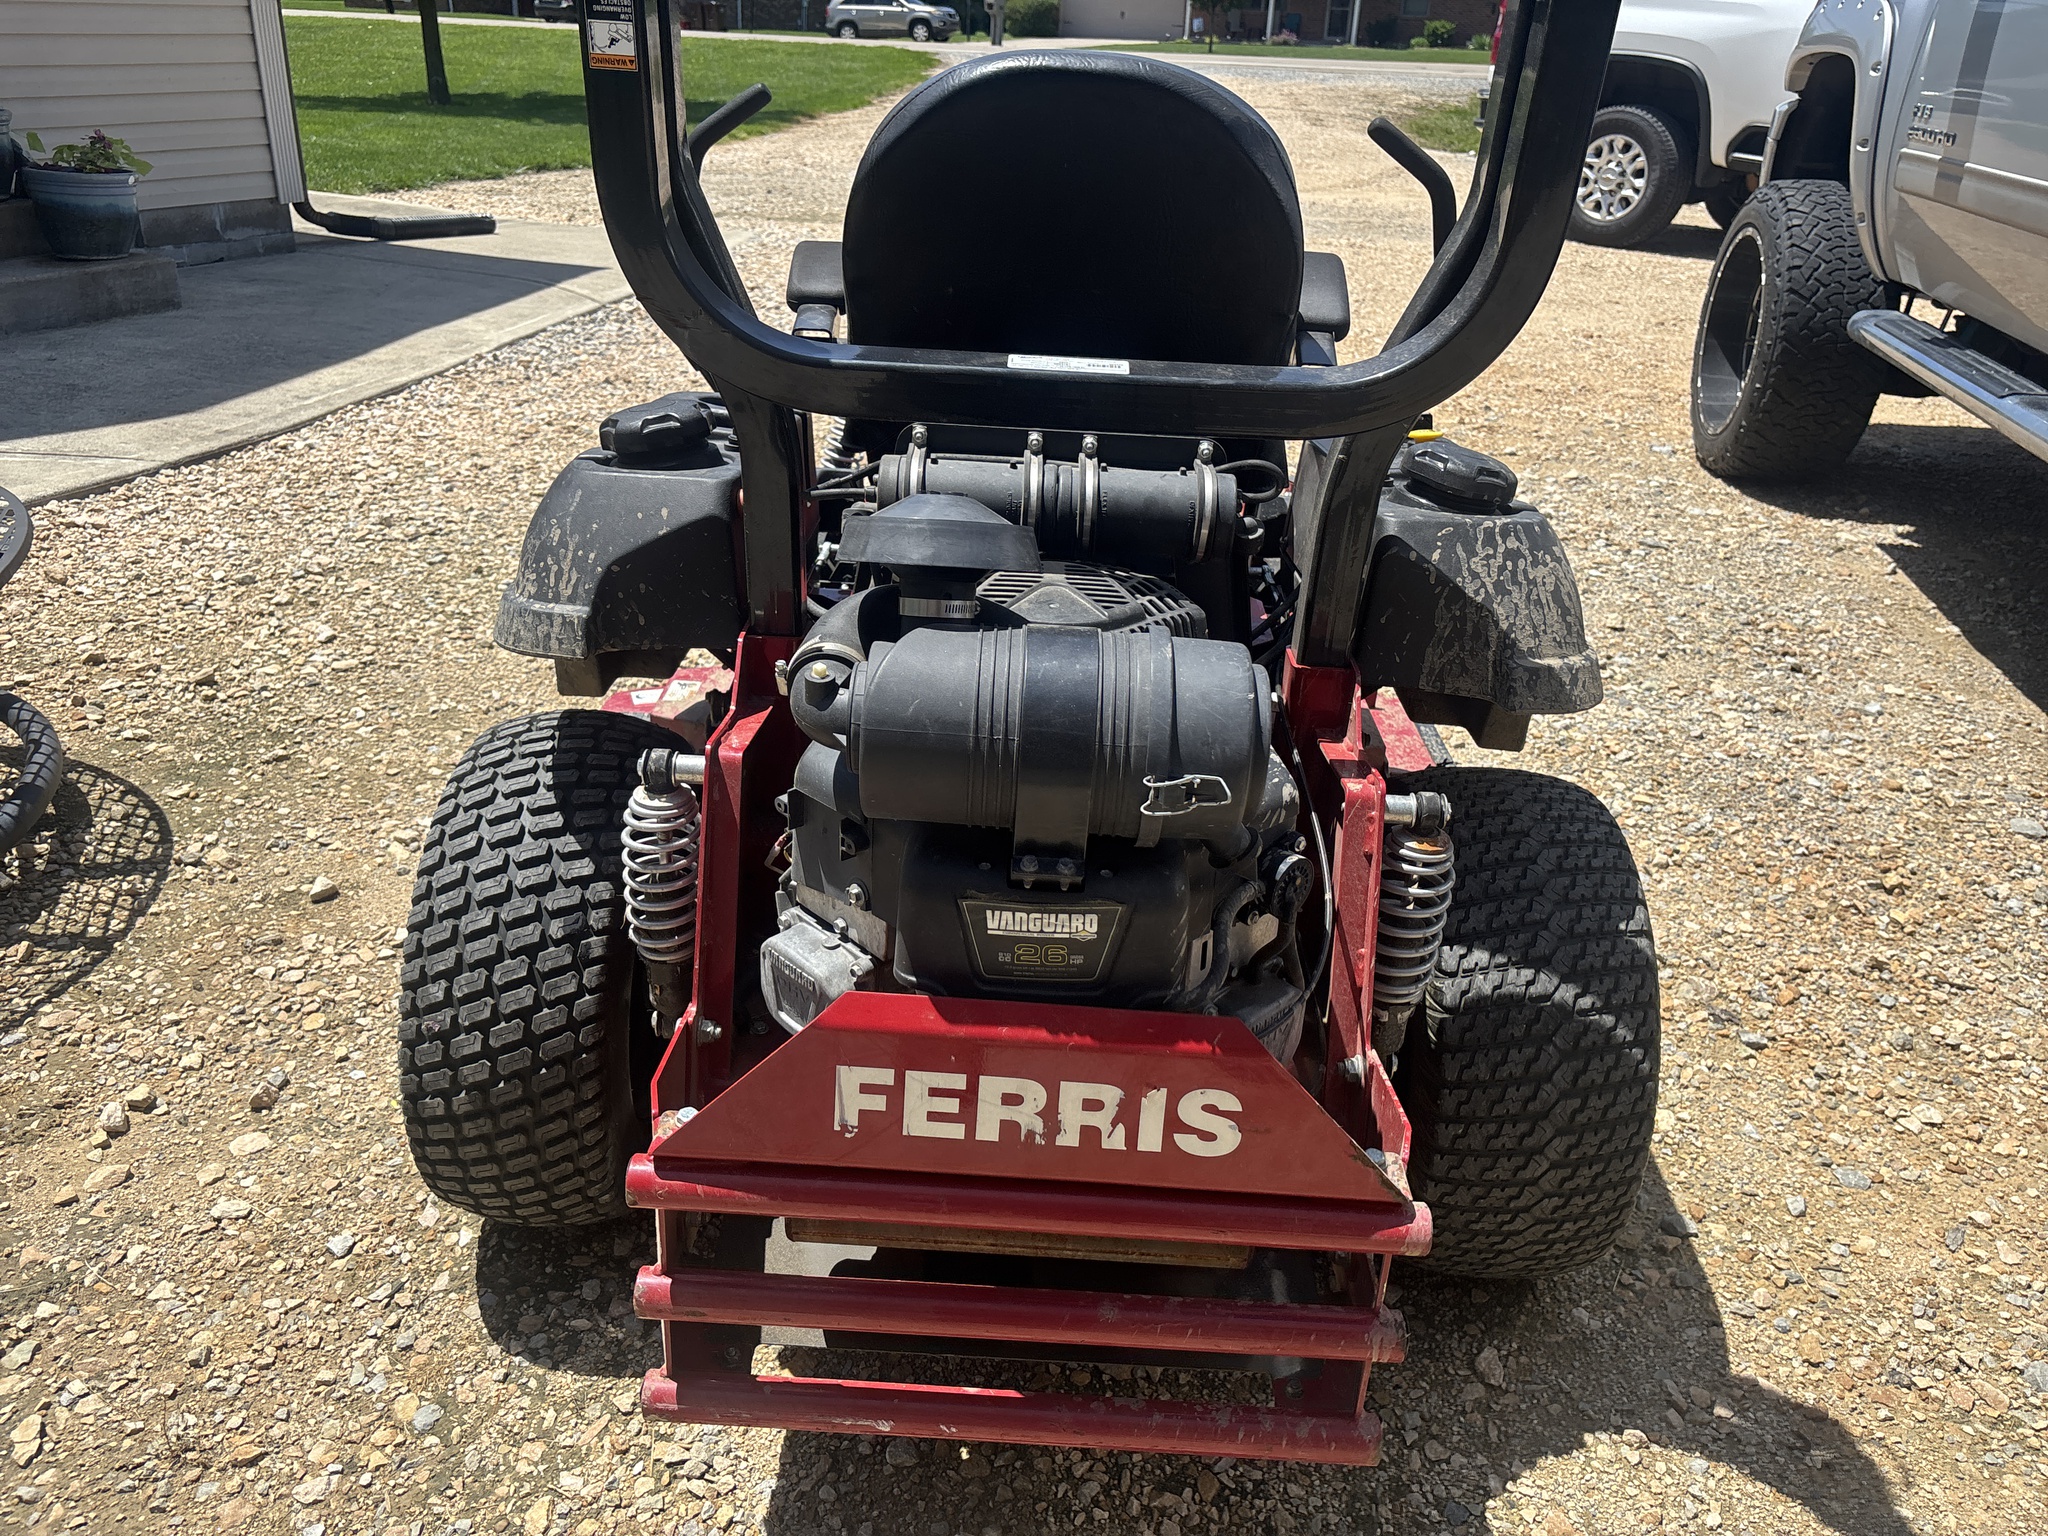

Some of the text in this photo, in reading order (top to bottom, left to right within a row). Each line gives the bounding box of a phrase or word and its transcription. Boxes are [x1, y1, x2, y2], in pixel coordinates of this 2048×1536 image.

[593, 5, 632, 13] OVERHANGING
[592, 56, 628, 66] WARNING
[986, 910, 1098, 933] VANGUARD
[1015, 944, 1067, 965] 26
[833, 1064, 1243, 1158] FERRIS
